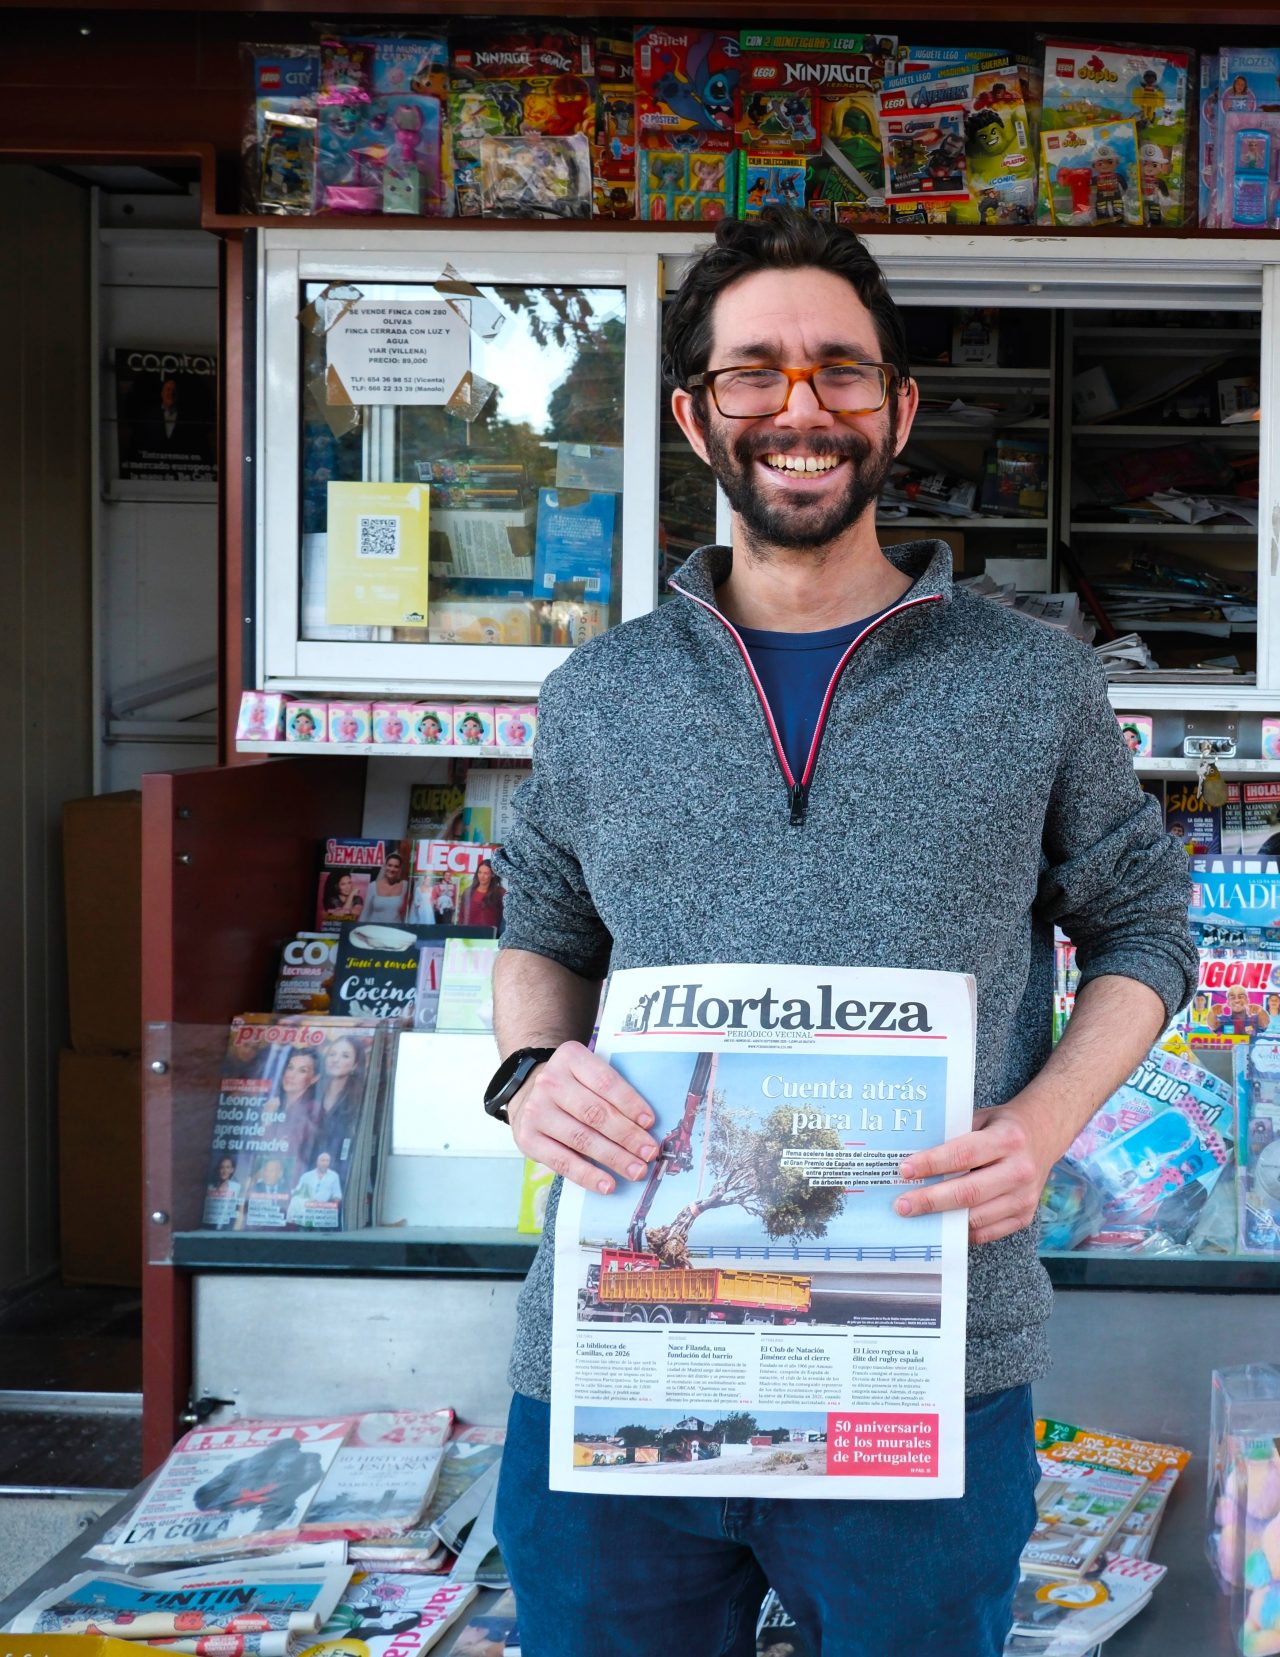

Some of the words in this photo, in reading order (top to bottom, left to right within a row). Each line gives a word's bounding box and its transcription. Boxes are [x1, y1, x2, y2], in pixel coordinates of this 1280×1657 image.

[745, 36, 763, 46] CON
[833, 38, 855, 50] LEGO
[915, 50, 942, 59] JUGUETE
[943, 51, 960, 60] LEGO
[285, 72, 312, 84] CITY
[752, 67, 776, 78] LEGO
[782, 62, 875, 90] NINJAGO
[888, 75, 915, 88] JUGUETE
[916, 72, 932, 82] LEGO
[1078, 68, 1118, 82] duplo
[884, 99, 905, 109] LEGO
[1247, 784, 1280, 797] ¡HOLA!
[325, 839, 385, 866] SEMANA
[339, 975, 416, 1001] Cocina
[654, 984, 932, 1033] Hortaleza
[235, 1025, 325, 1046] pronto
[727, 1029, 773, 1038] PERIÓDICO
[775, 1030, 813, 1039] VECINAL
[761, 1075, 853, 1101] Cuenta
[862, 1077, 928, 1101] atrás
[217, 1109, 243, 1121] todo
[245, 1110, 259, 1122] lo
[261, 1111, 287, 1125] que
[792, 1112, 851, 1136] para
[861, 1108, 884, 1131] la
[892, 1109, 925, 1132] F1
[214, 1124, 266, 1139] aprende
[212, 1138, 227, 1150] de
[228, 1140, 244, 1150] su
[246, 1139, 289, 1151] madre
[576, 1350, 604, 1358] Canillas,
[686, 1344, 711, 1352] Filanda,
[881, 1349, 905, 1357] regresa
[760, 1353, 786, 1361] Jiménez
[879, 1356, 898, 1364] rugby
[899, 1356, 924, 1364] español
[835, 1421, 852, 1433] 50
[855, 1421, 931, 1434] aniversario
[185, 1422, 347, 1450] muy
[834, 1435, 850, 1448] de
[854, 1435, 873, 1448] los
[877, 1436, 931, 1448] murales
[833, 1450, 850, 1462] de
[853, 1451, 931, 1466] Portugalete
[124, 1528, 155, 1545] LA
[164, 1520, 229, 1541] COLA
[136, 1586, 257, 1606] TINTIN
